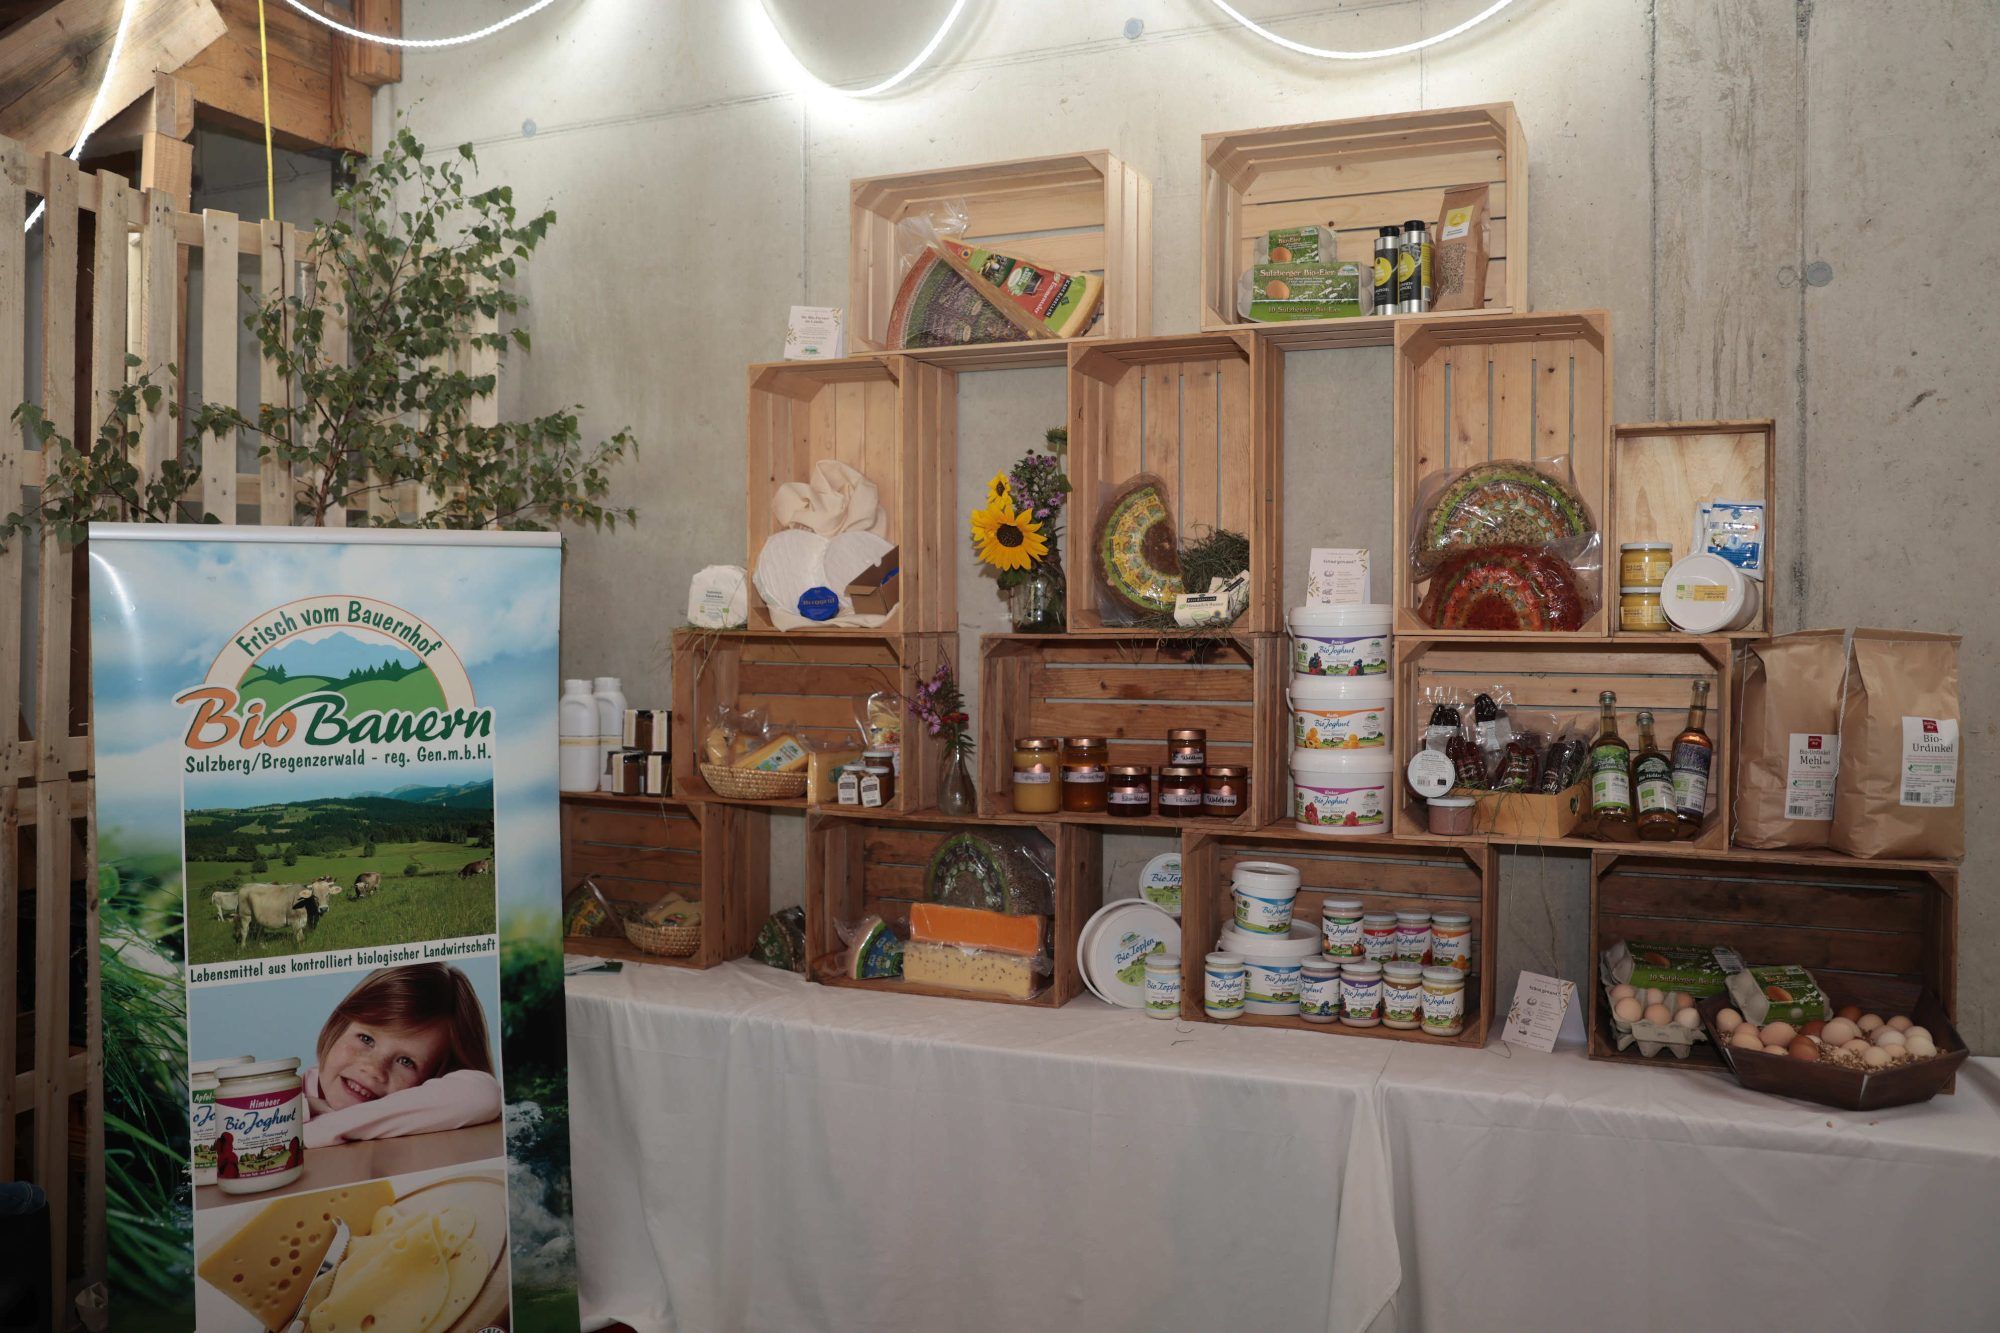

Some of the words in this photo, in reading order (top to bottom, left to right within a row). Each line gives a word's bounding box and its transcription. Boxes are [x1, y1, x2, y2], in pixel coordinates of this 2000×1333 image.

[1259, 269, 1302, 279] Sulzberger
[1303, 268, 1336, 276] Bio-Eier
[1278, 306, 1313, 315] Sulzberger
[236, 611, 298, 657] Frisch
[300, 605, 340, 627] vom
[347, 600, 443, 657] Bauernhof
[1318, 645, 1330, 653] Bio
[1328, 645, 1356, 656] Joghurt
[176, 687, 297, 750] Bio
[282, 694, 493, 746] Bauern
[1313, 719, 1325, 727] Bio
[1323, 718, 1350, 730] Joghurt
[1923, 734, 1943, 743] Bio-
[1912, 743, 1953, 753] Urdinkel
[185, 748, 365, 775] Sulzberg/Bregenzerwald
[385, 751, 410, 768] reg.
[417, 743, 492, 763] Gen.m.b.H.
[1800, 755, 1822, 765] Mehl
[1313, 796, 1324, 804] Bio
[1322, 796, 1349, 807] Joghurt
[1151, 873, 1167, 882] Bio
[1167, 873, 1183, 885] Top
[1332, 924, 1358, 936] Joghurt
[1372, 937, 1395, 948] Joghurt
[1402, 935, 1426, 946] Joghurt
[1114, 952, 1130, 965] Bio
[1129, 937, 1156, 957] Topfen
[190, 966, 264, 983] Lebensmittel
[268, 962, 286, 976] aus
[291, 954, 353, 973] kontrolliert
[357, 948, 421, 970] biologischer
[423, 938, 496, 959] Landwirtschaft
[1264, 974, 1275, 982] Bio
[1274, 973, 1300, 985] Joghurt
[1659, 973, 1697, 984] Sulzberger
[1146, 979, 1157, 990] Bio
[1156, 981, 1182, 993] Topfen
[1209, 980, 1221, 989] Bio
[1219, 980, 1243, 991] Joghurt
[1344, 989, 1354, 997] Bio
[1352, 989, 1378, 999] Joghurt
[1385, 989, 1393, 998] Bio
[1392, 989, 1418, 1001] Joghurt
[1428, 996, 1455, 1007] Joghurt
[194, 1092, 215, 1103] Apfel-
[249, 1098, 281, 1109] Himbeer
[224, 1116, 246, 1131] Bio
[243, 1108, 297, 1135] Joghurt
